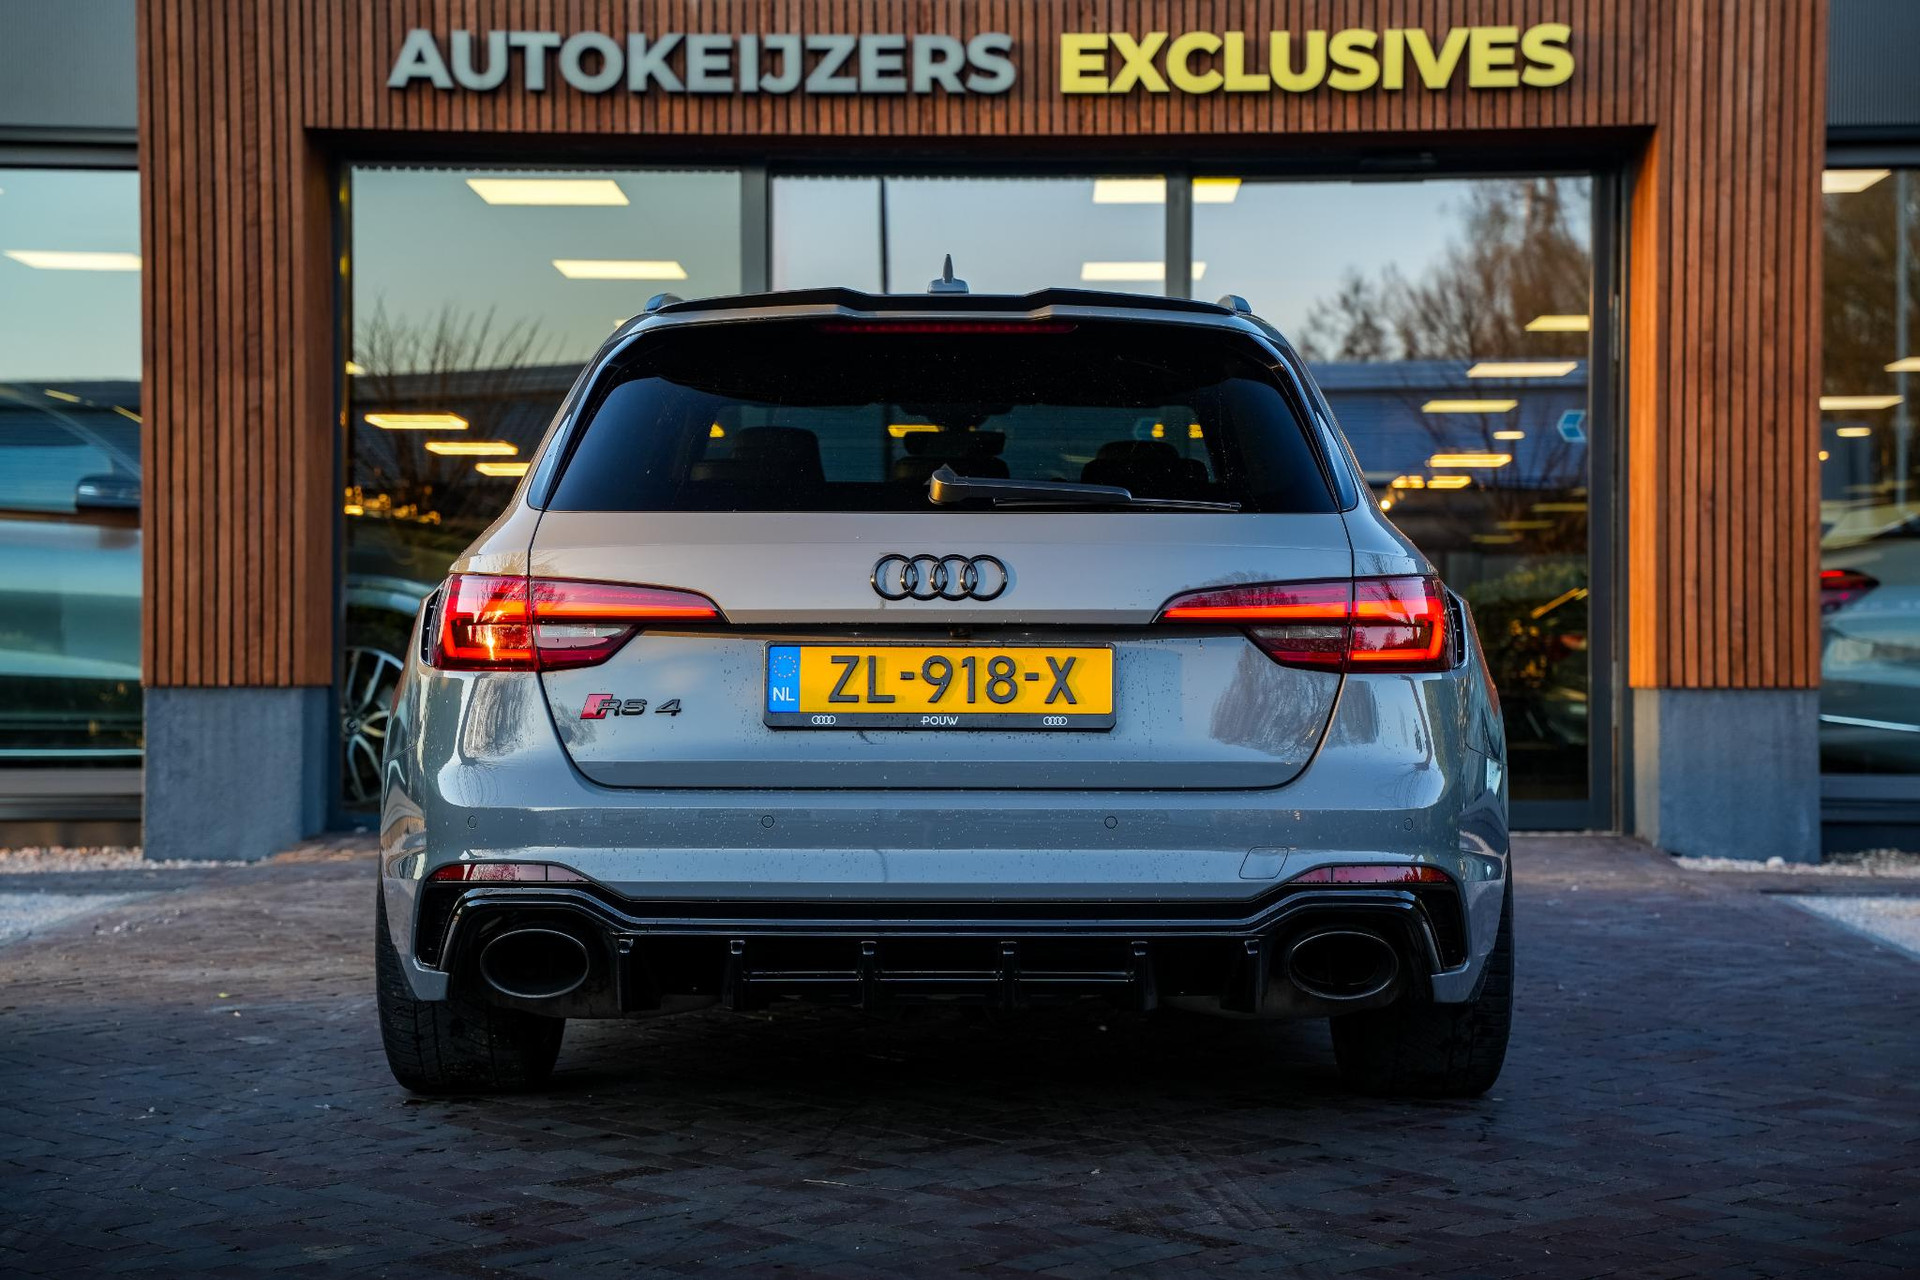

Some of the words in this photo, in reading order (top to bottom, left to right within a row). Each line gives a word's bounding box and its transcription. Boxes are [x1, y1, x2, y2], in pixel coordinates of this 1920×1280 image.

[387, 28, 1017, 95] AUTOKEIJZERS
[1059, 22, 1576, 94] EXCLUSIVES
[828, 654, 1078, 705] ZL-918-X
[773, 686, 795, 701] NL
[596, 698, 647, 716] RS
[655, 698, 682, 716] 4
[920, 716, 959, 726] POUW
